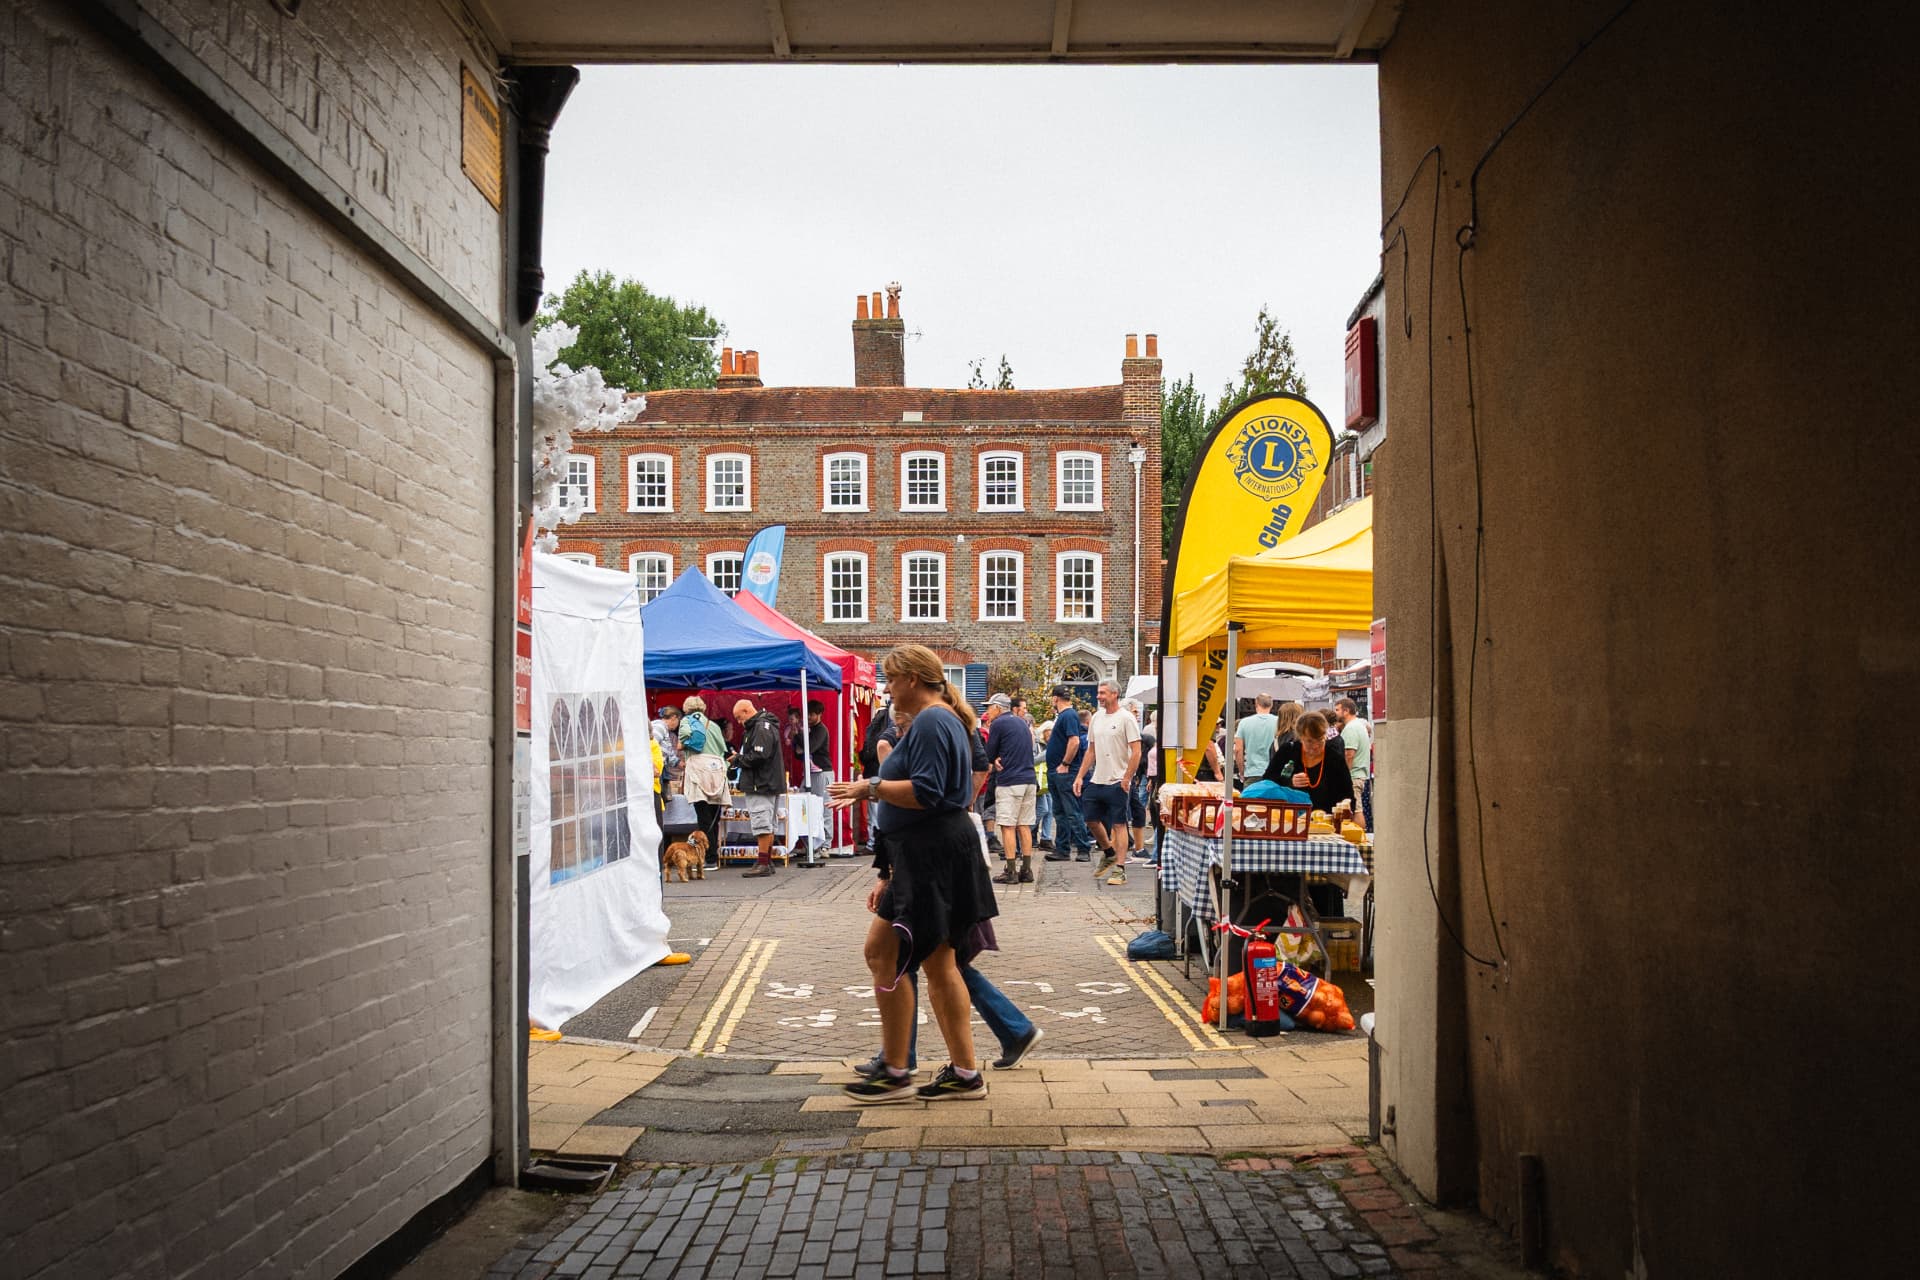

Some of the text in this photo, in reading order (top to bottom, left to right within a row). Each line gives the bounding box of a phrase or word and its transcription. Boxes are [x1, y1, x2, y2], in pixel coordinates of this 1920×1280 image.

[1251, 418, 1302, 440] LIONS
[1261, 441, 1285, 472] L
[1244, 476, 1294, 495] INTERNATIONAL
[1258, 503, 1293, 549] Club
